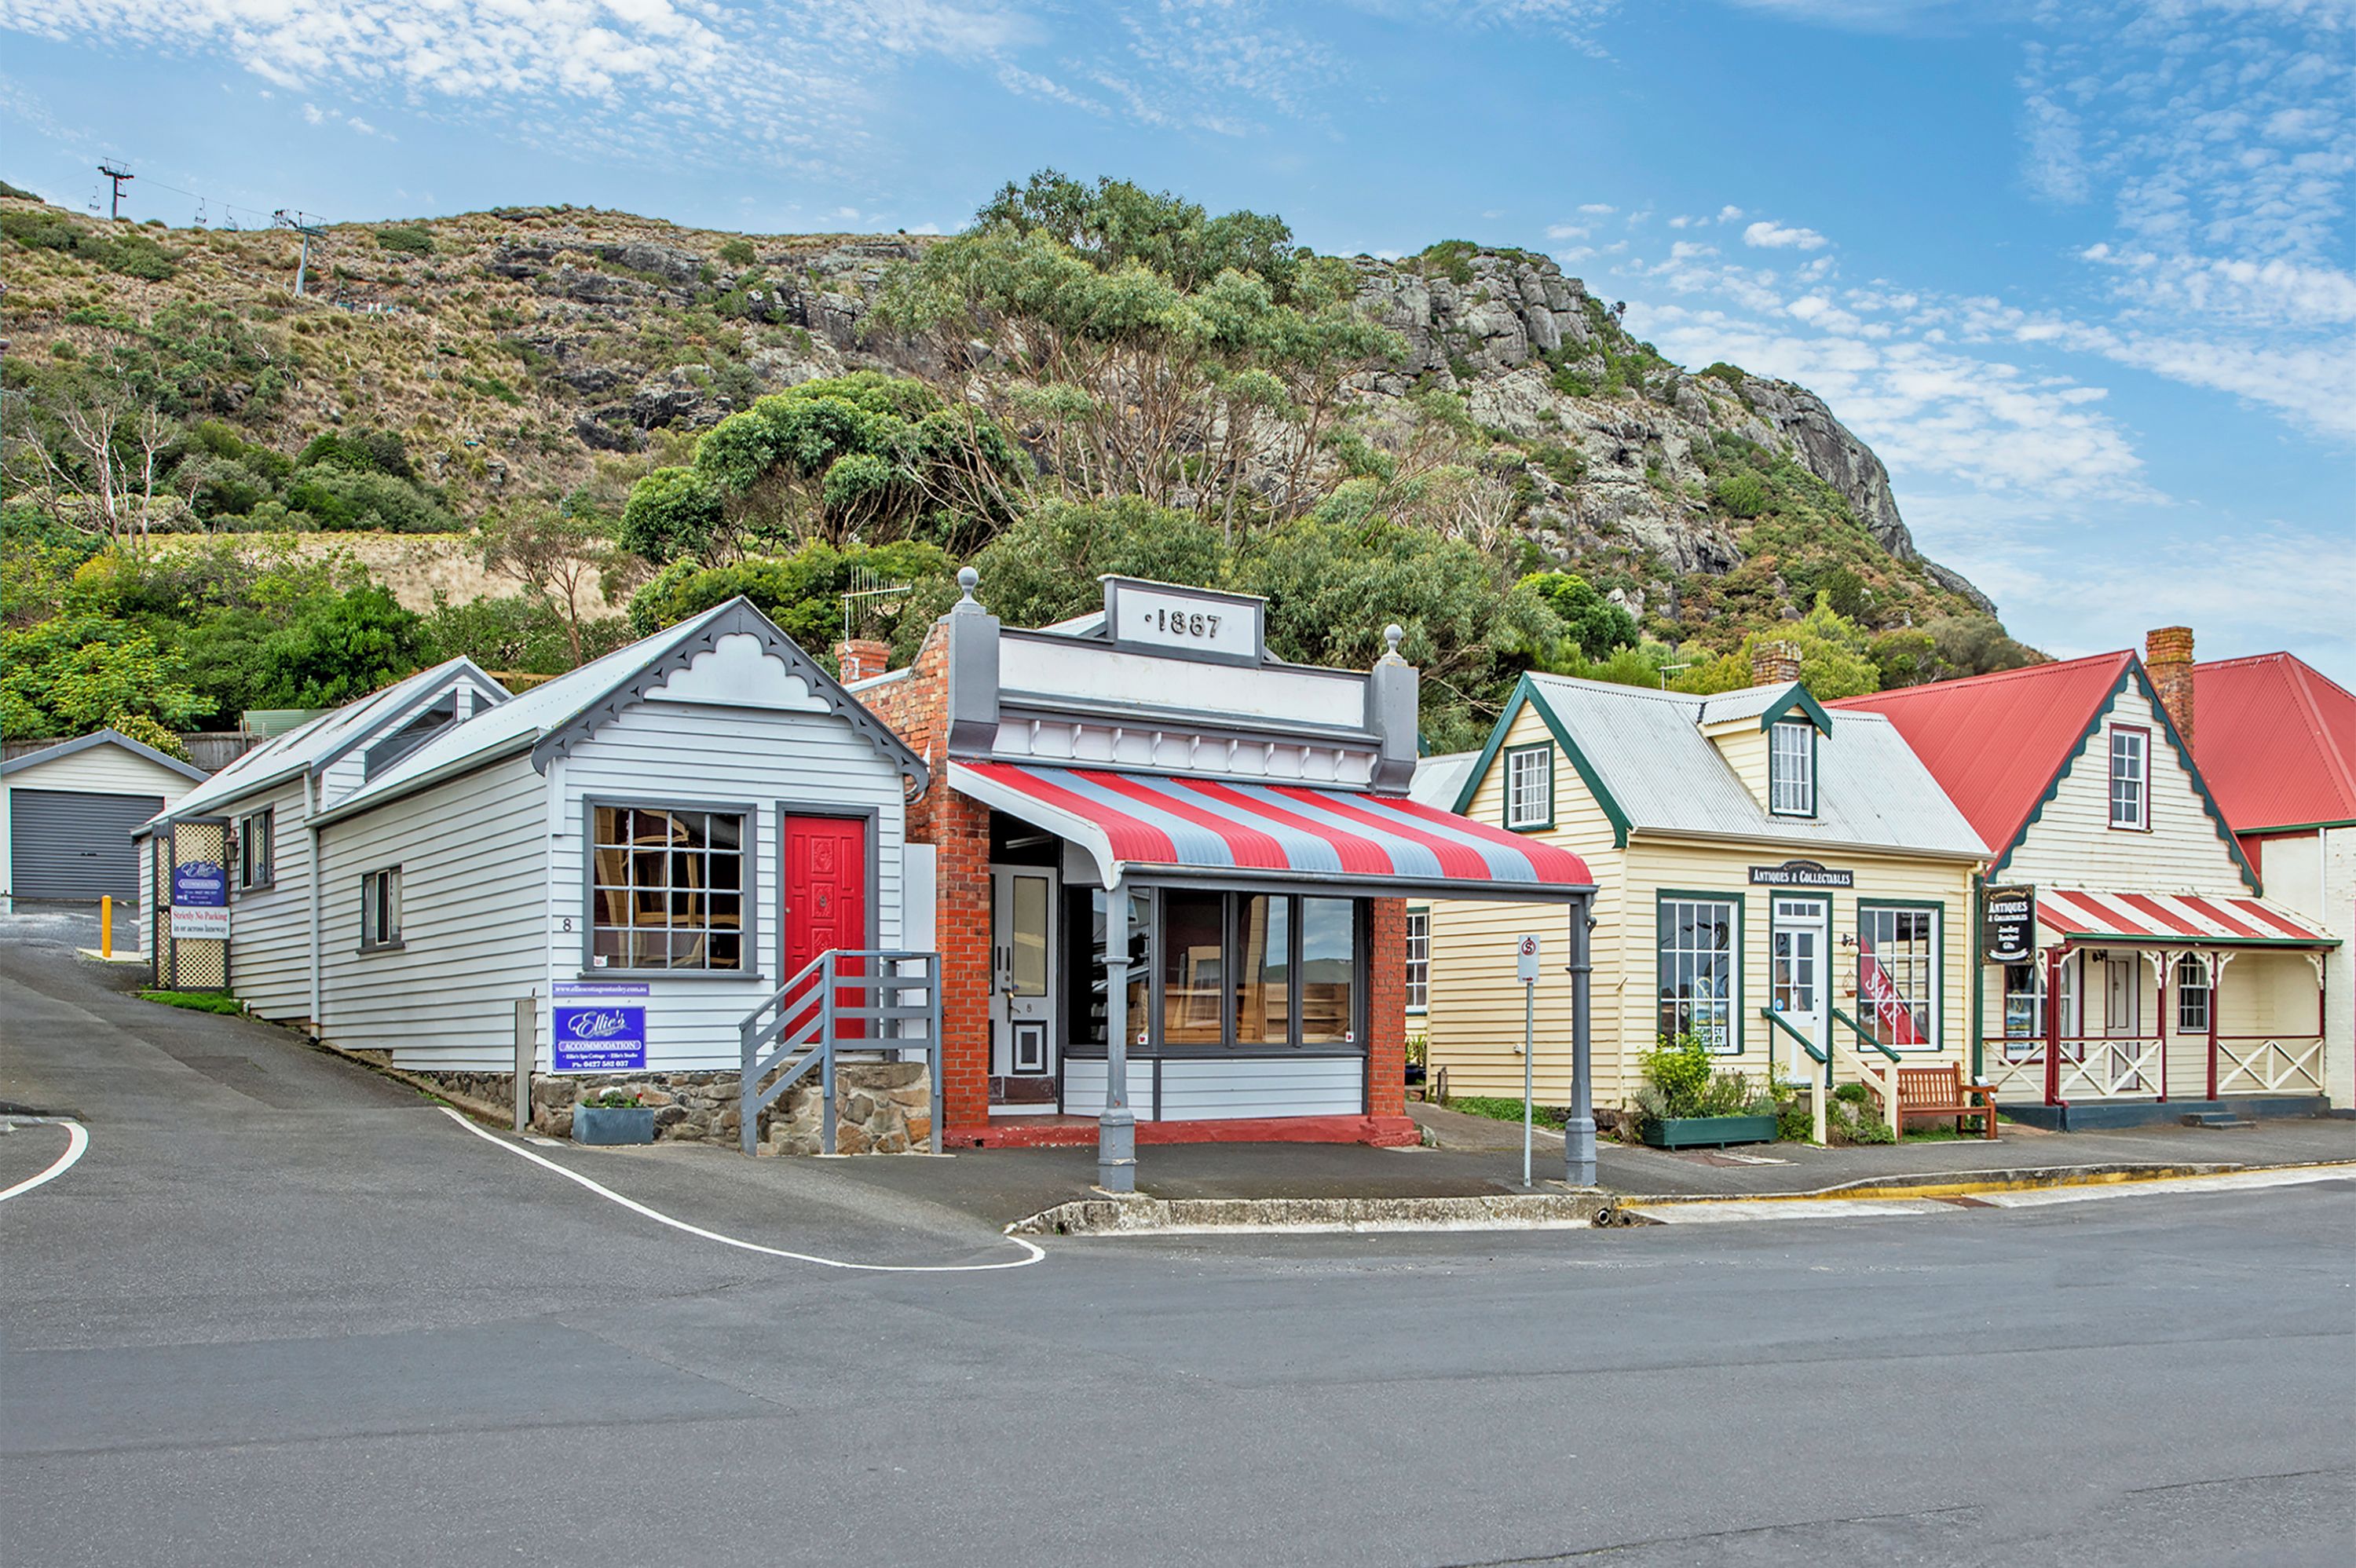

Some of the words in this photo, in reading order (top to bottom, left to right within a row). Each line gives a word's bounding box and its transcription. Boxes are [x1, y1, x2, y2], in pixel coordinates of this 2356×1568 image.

[1158, 609, 1222, 638] 1887
[1753, 868, 1790, 884] ANTIQUES
[1791, 872, 1798, 883] &
[1799, 870, 1851, 885] COLLECTABLES
[1988, 901, 2029, 914] ANTIQUES
[196, 911, 203, 920] No
[205, 911, 228, 922] Parking
[562, 918, 572, 933] 8
[568, 1009, 627, 1039] Ellie's
[565, 1041, 635, 1051] ACCOMMODATION
